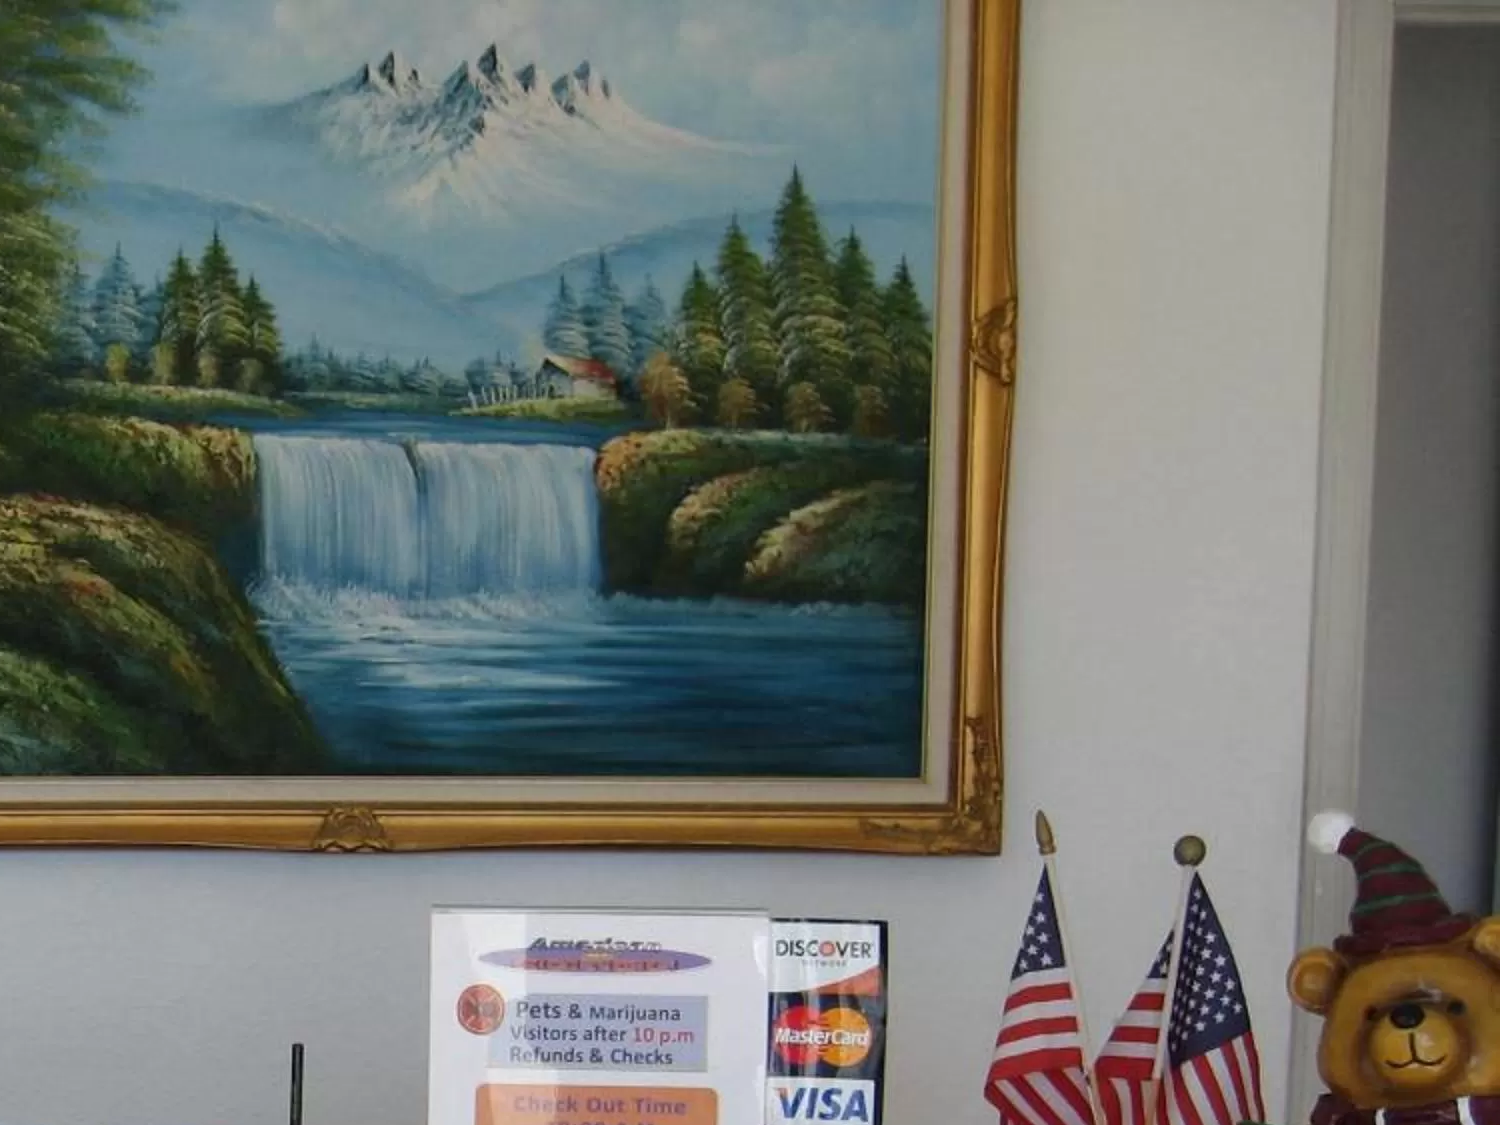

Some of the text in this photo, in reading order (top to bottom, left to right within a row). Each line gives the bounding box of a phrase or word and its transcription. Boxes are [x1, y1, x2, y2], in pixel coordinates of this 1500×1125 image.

[775, 939, 872, 959] DISCOVER
[516, 1001, 681, 1024] Pets & Marijuana
[510, 1024, 695, 1046] Visitors after 10 p.m
[775, 1027, 870, 1045] MasterCard
[509, 1047, 673, 1065] Refunds & Checks
[513, 1094, 687, 1116] Check Out Time
[775, 1087, 870, 1123] VISA
